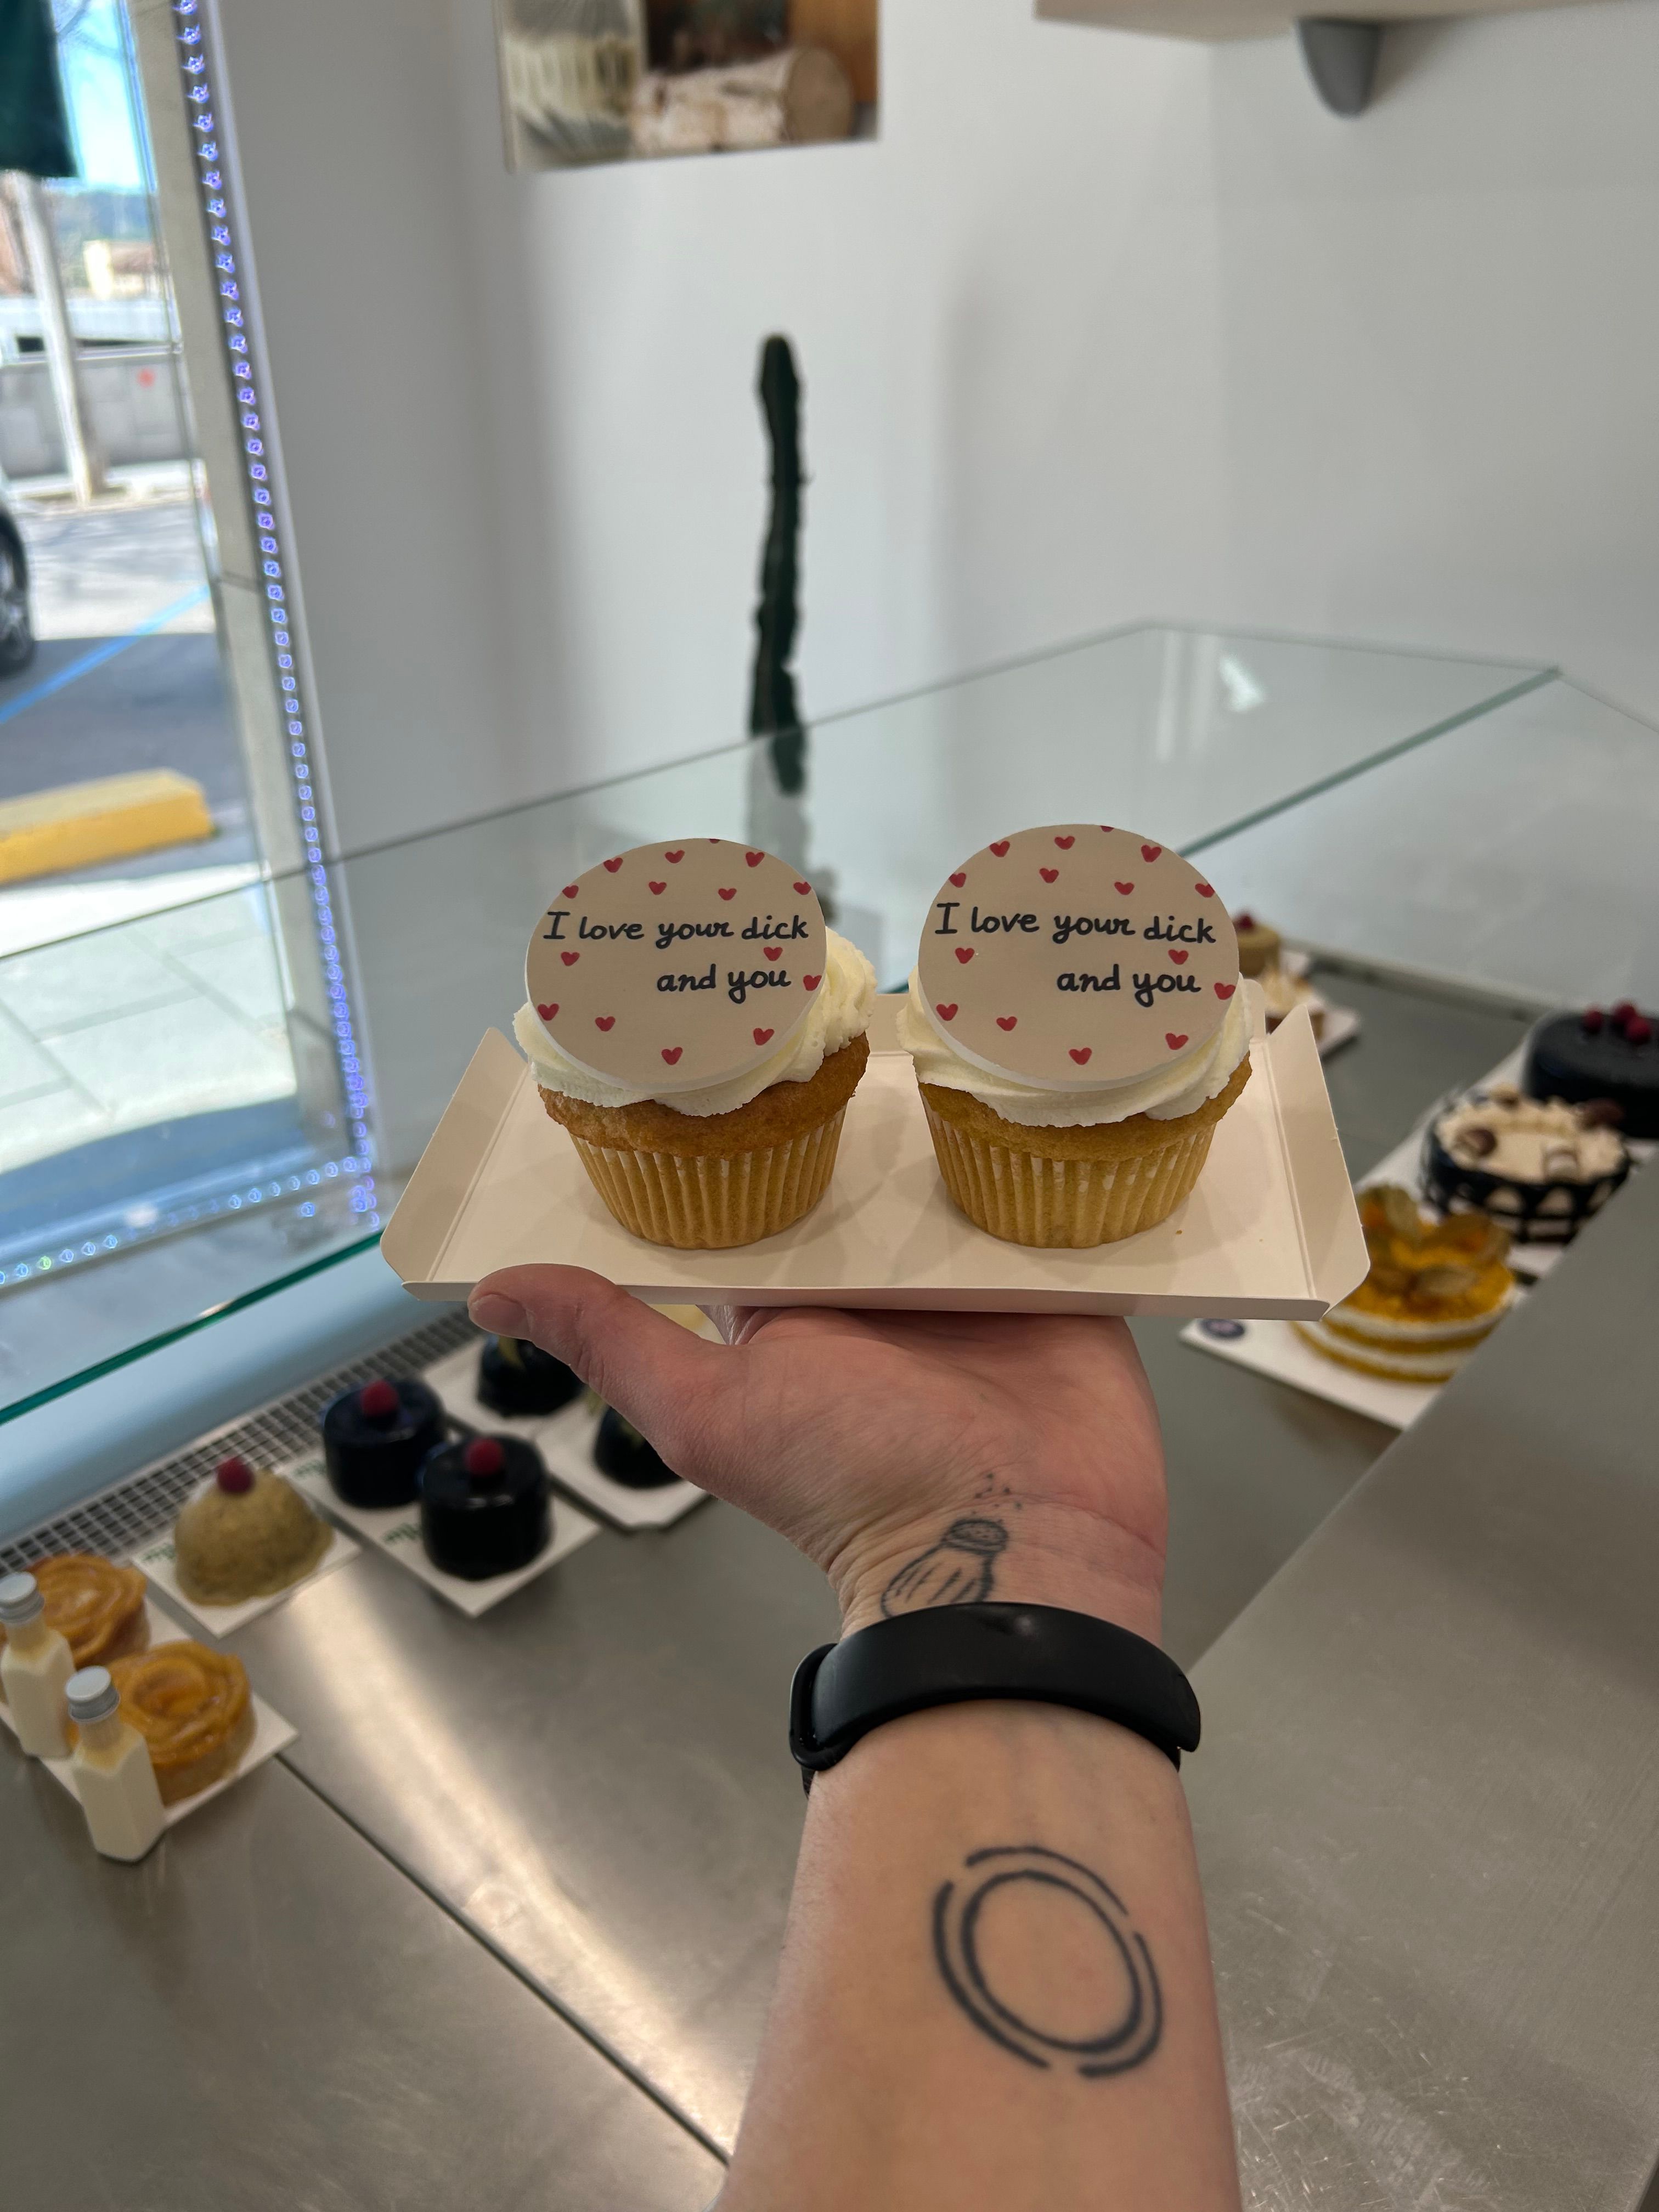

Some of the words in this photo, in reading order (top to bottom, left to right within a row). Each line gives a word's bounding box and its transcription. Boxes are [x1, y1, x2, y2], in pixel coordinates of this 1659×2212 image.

[543, 911, 571, 940] I
[579, 916, 645, 940] love
[655, 922, 735, 950] your
[741, 915, 810, 940] dick
[934, 902, 960, 935] I
[971, 906, 1040, 933] love
[1052, 915, 1136, 944] your
[1143, 915, 1216, 944] dick
[656, 963, 716, 992] and
[727, 970, 792, 1005] you
[1057, 963, 1121, 992] and
[1132, 973, 1201, 1008] you
